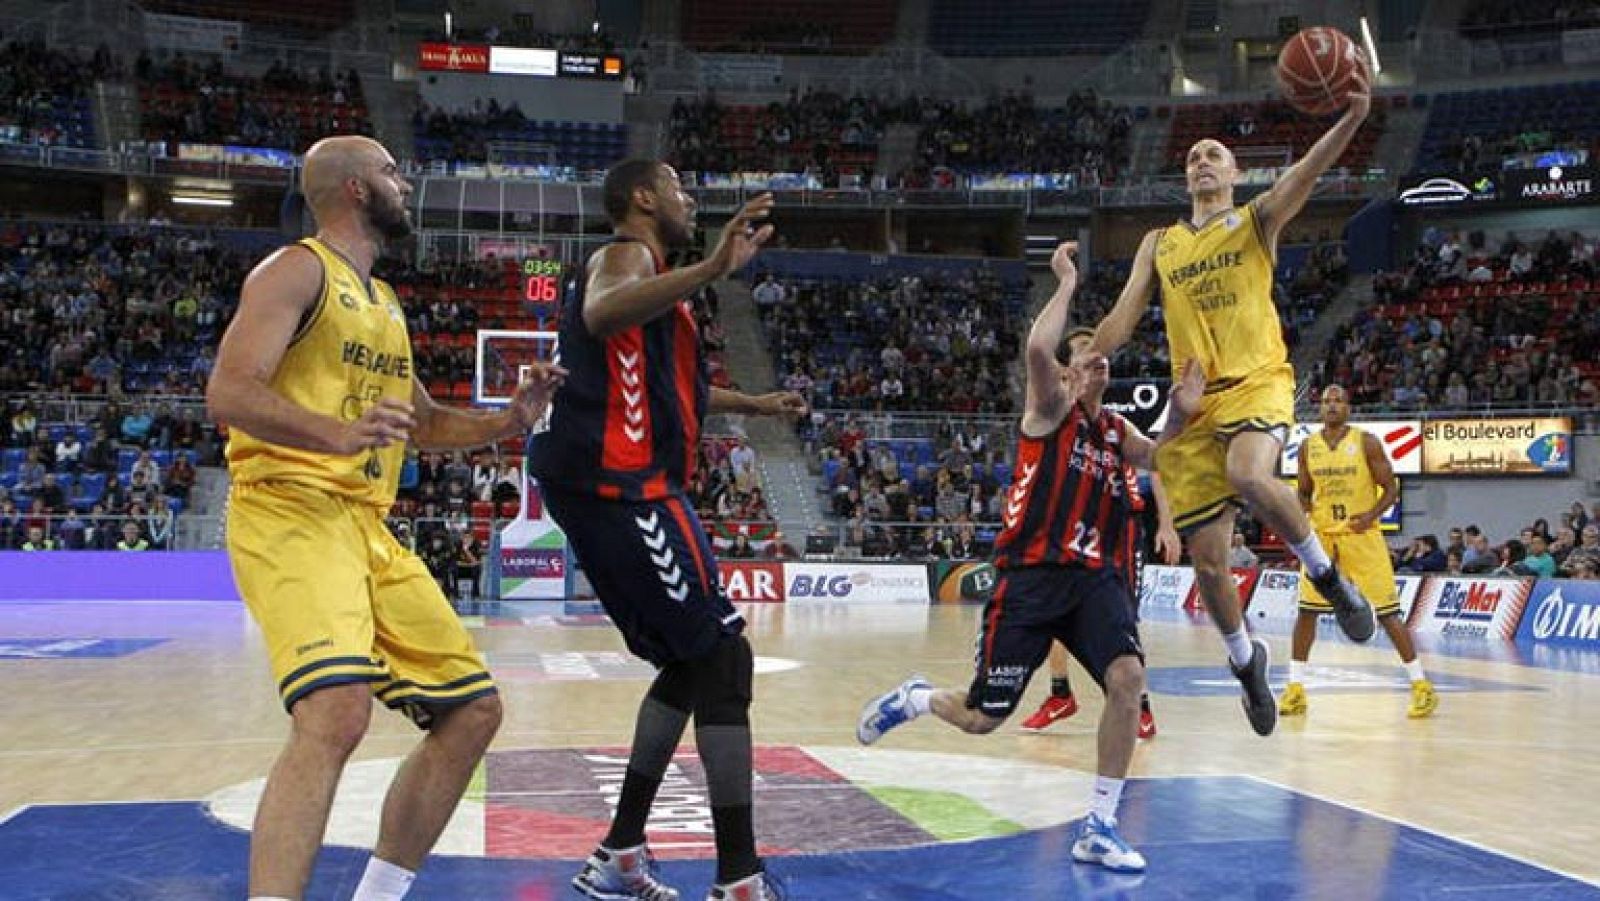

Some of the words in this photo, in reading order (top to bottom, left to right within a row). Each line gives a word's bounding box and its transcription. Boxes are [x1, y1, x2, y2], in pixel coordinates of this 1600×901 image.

[1521, 179, 1590, 197] ARABARTE
[526, 275, 558, 301] 06
[1424, 424, 1440, 440] el
[1443, 421, 1536, 440] Boulevard
[1331, 504, 1347, 521] 13
[1068, 520, 1101, 559] 22
[502, 557, 549, 568] LABORAL
[789, 574, 852, 598] BLG
[1437, 581, 1503, 616] BigMat
